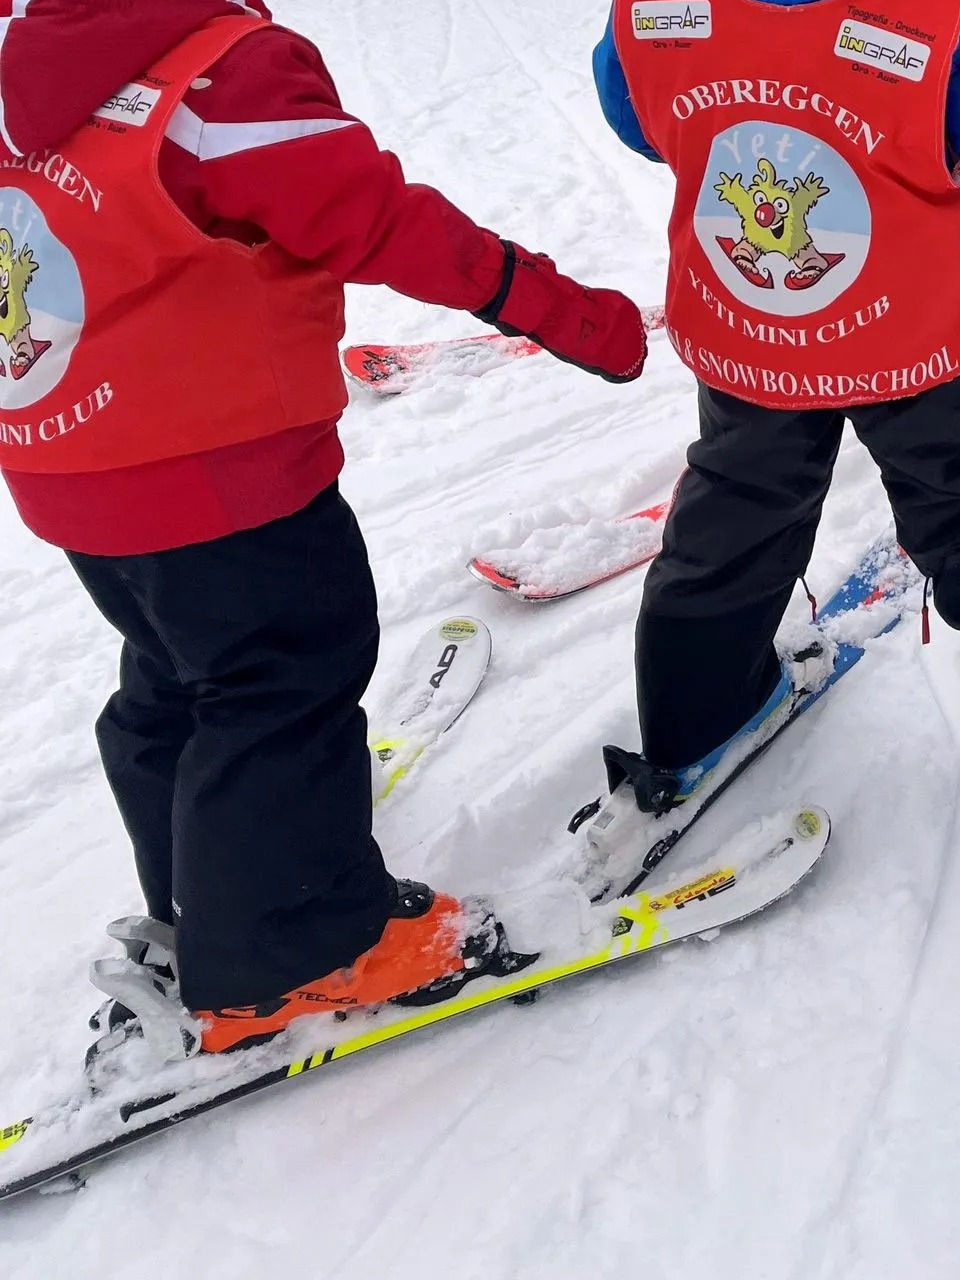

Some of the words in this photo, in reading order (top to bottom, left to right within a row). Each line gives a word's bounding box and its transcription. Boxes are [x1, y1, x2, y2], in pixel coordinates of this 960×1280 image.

[672, 78, 886, 155] OBEREGGEN
[720, 130, 822, 172] Yeti
[688, 267, 735, 329] YETI
[741, 318, 809, 348] MINI
[816, 295, 891, 344] CLUB
[698, 345, 960, 397] SNOWBOARDSCHOOL
[0, 421, 33, 446] INI
[39, 381, 114, 442] CLUB
